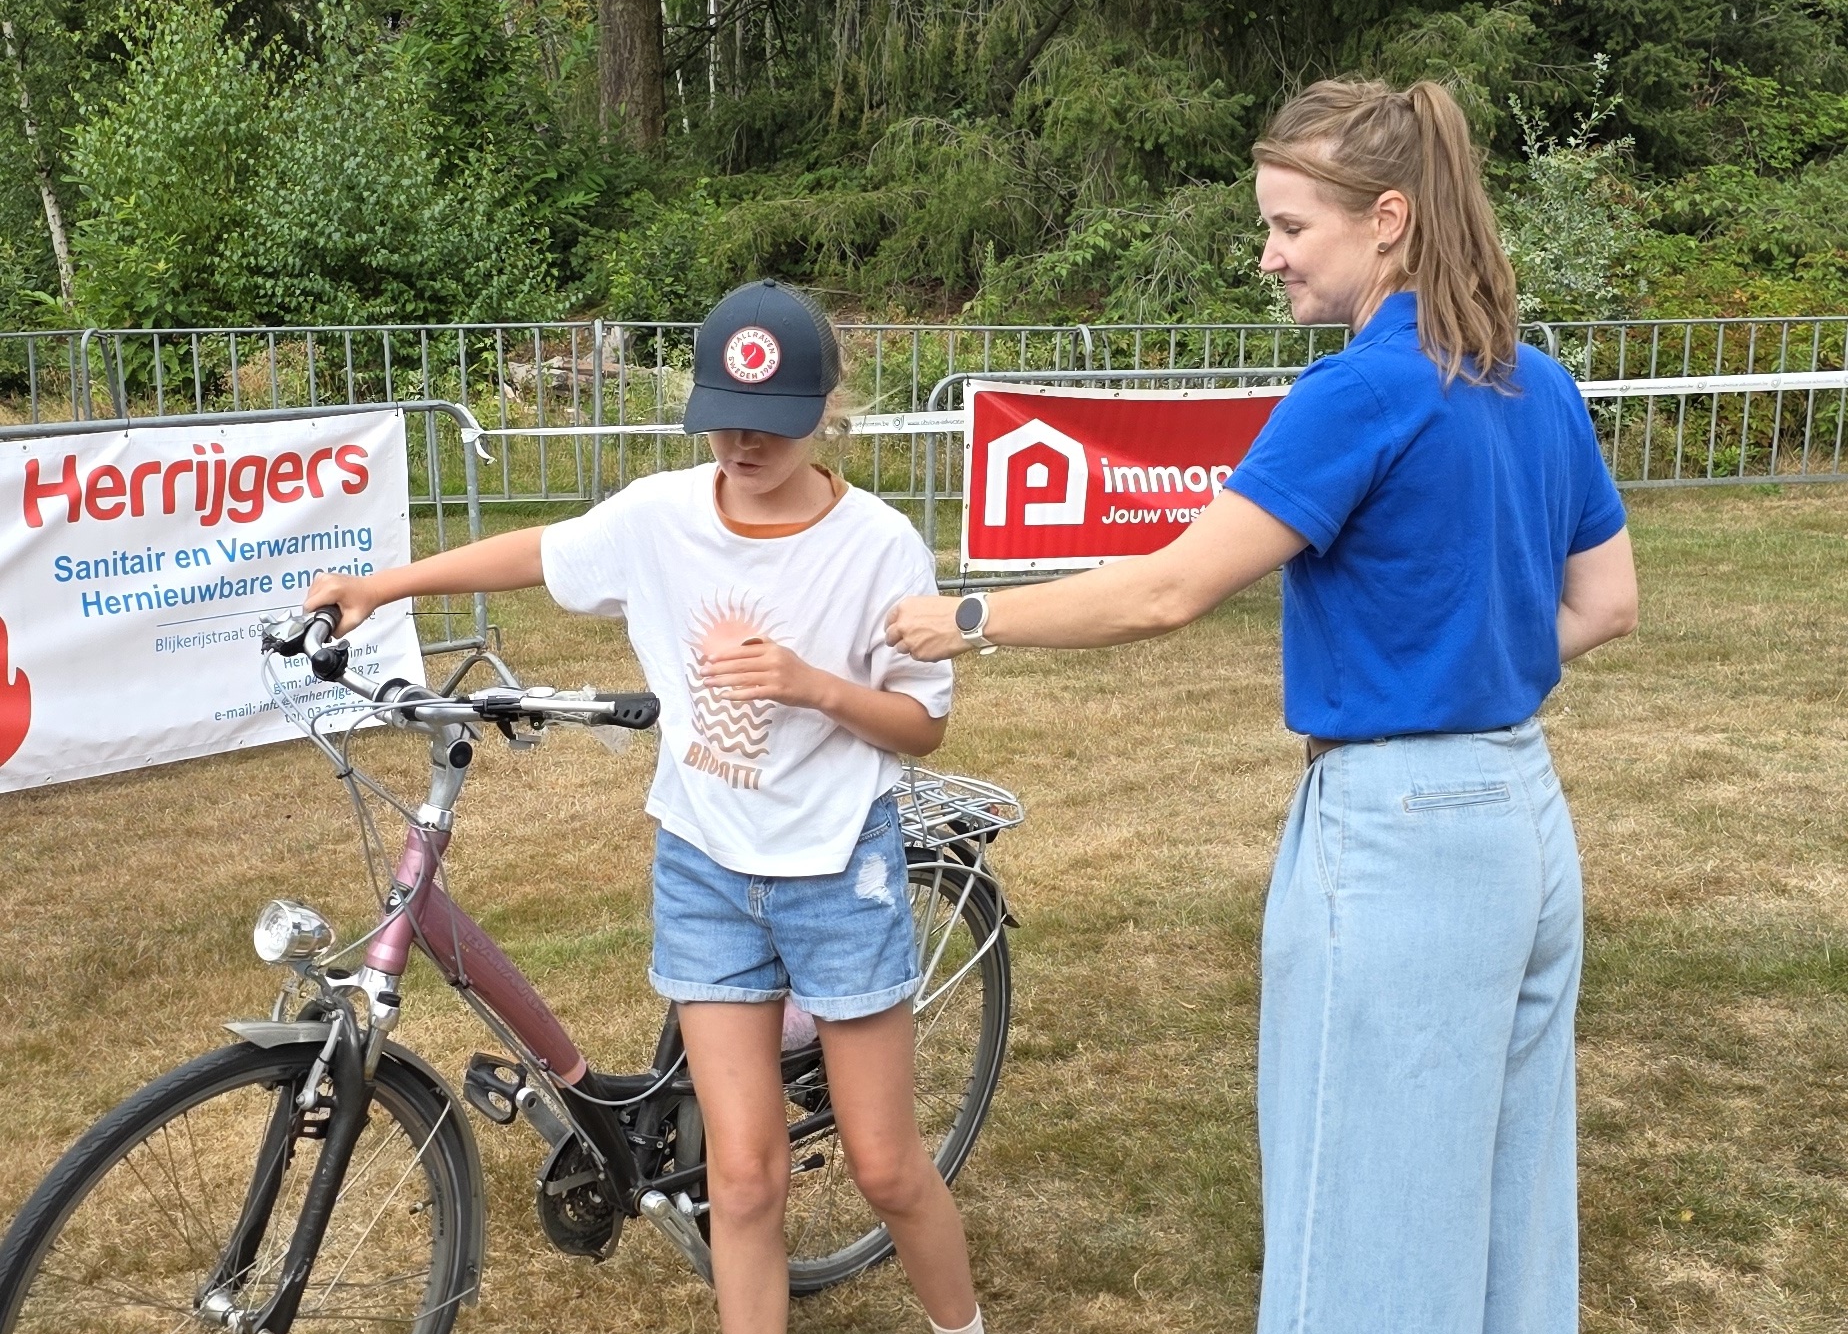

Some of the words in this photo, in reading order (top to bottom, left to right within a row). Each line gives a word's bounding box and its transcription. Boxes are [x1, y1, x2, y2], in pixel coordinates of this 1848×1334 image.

[728, 356, 758, 379] SWEDEN
[23, 442, 369, 528] Herrijgers
[1101, 505, 1162, 524] Jouw
[54, 546, 166, 583] Sanitair
[174, 547, 212, 569] en
[216, 524, 373, 563] Verwarming
[81, 575, 273, 618] Hernieuwbare
[281, 557, 374, 590] enie
[155, 626, 245, 654] Blijkerijstraat
[366, 643, 379, 656] bv
[366, 662, 380, 675] 72
[214, 702, 256, 721] e-mail:
